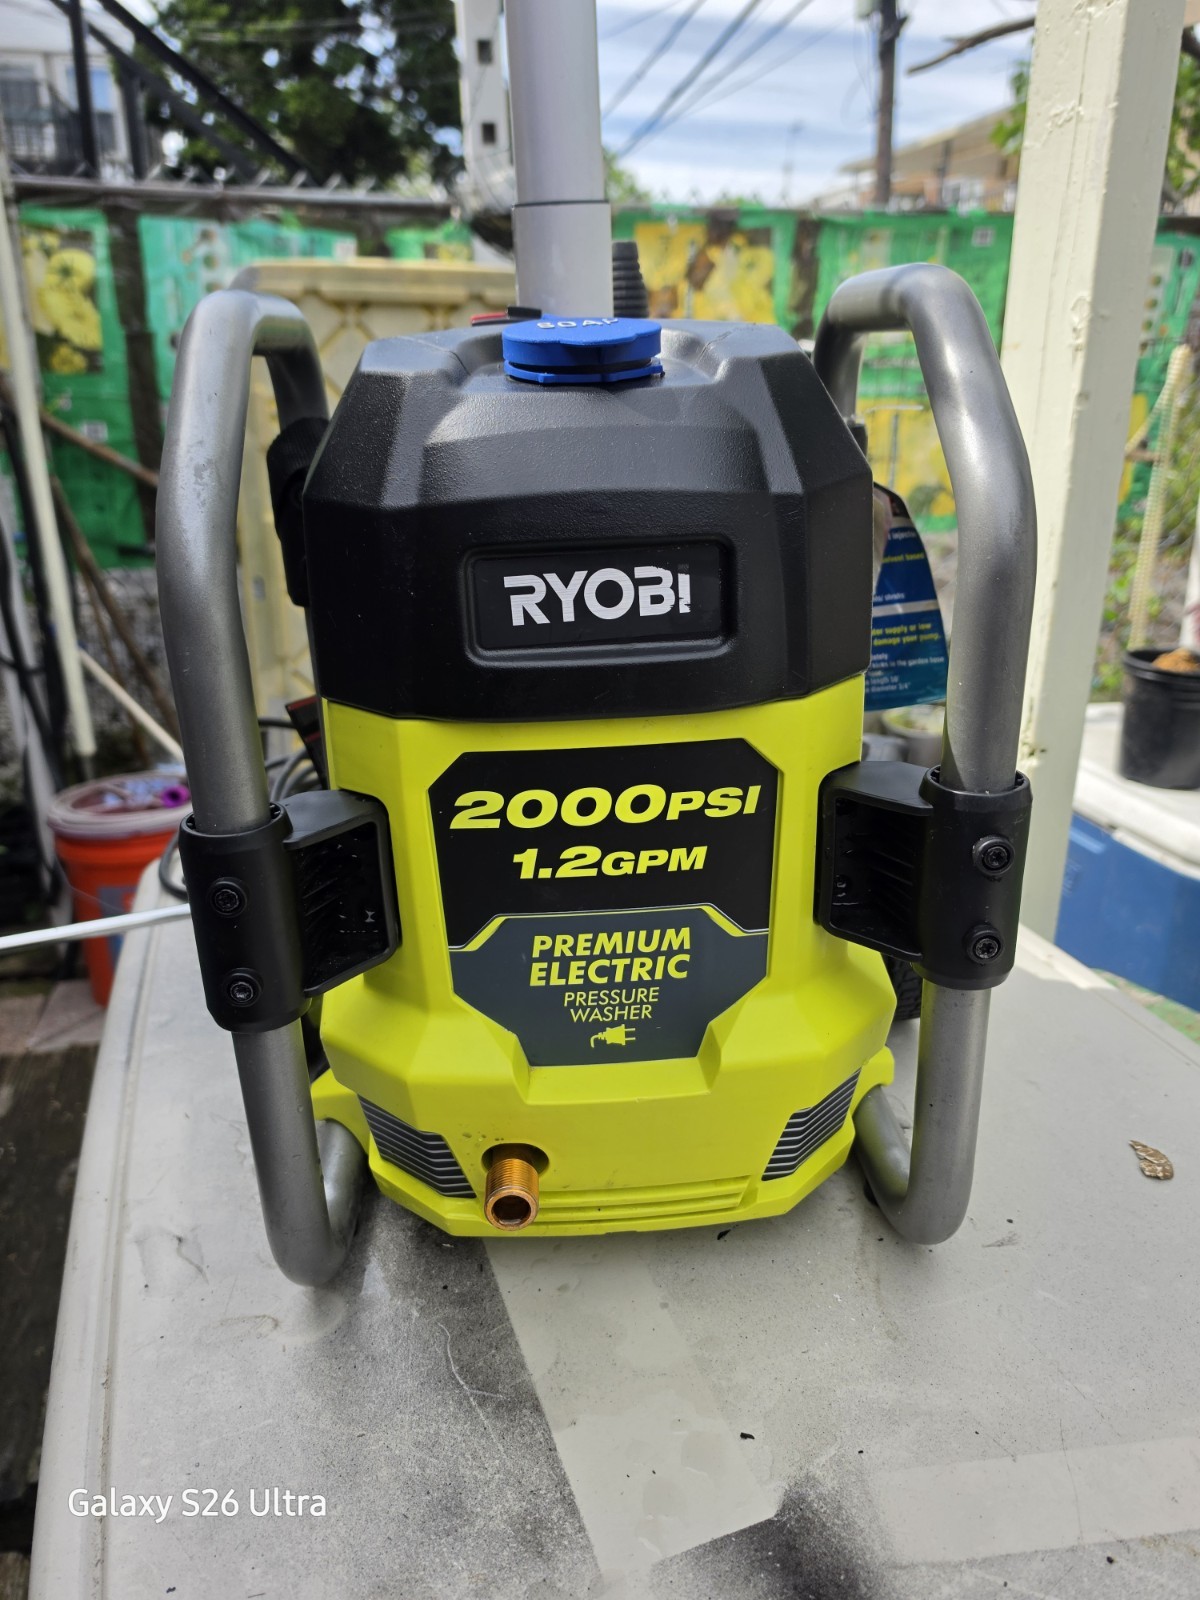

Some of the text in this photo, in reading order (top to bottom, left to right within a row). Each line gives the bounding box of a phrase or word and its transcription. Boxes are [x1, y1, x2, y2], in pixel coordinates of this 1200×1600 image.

[503, 564, 692, 626] RYOBI
[532, 927, 691, 958] PREMIUM
[530, 954, 691, 986] ELECTRIC
[564, 987, 660, 1007] PRESSURE
[570, 1005, 653, 1023] WASHER
